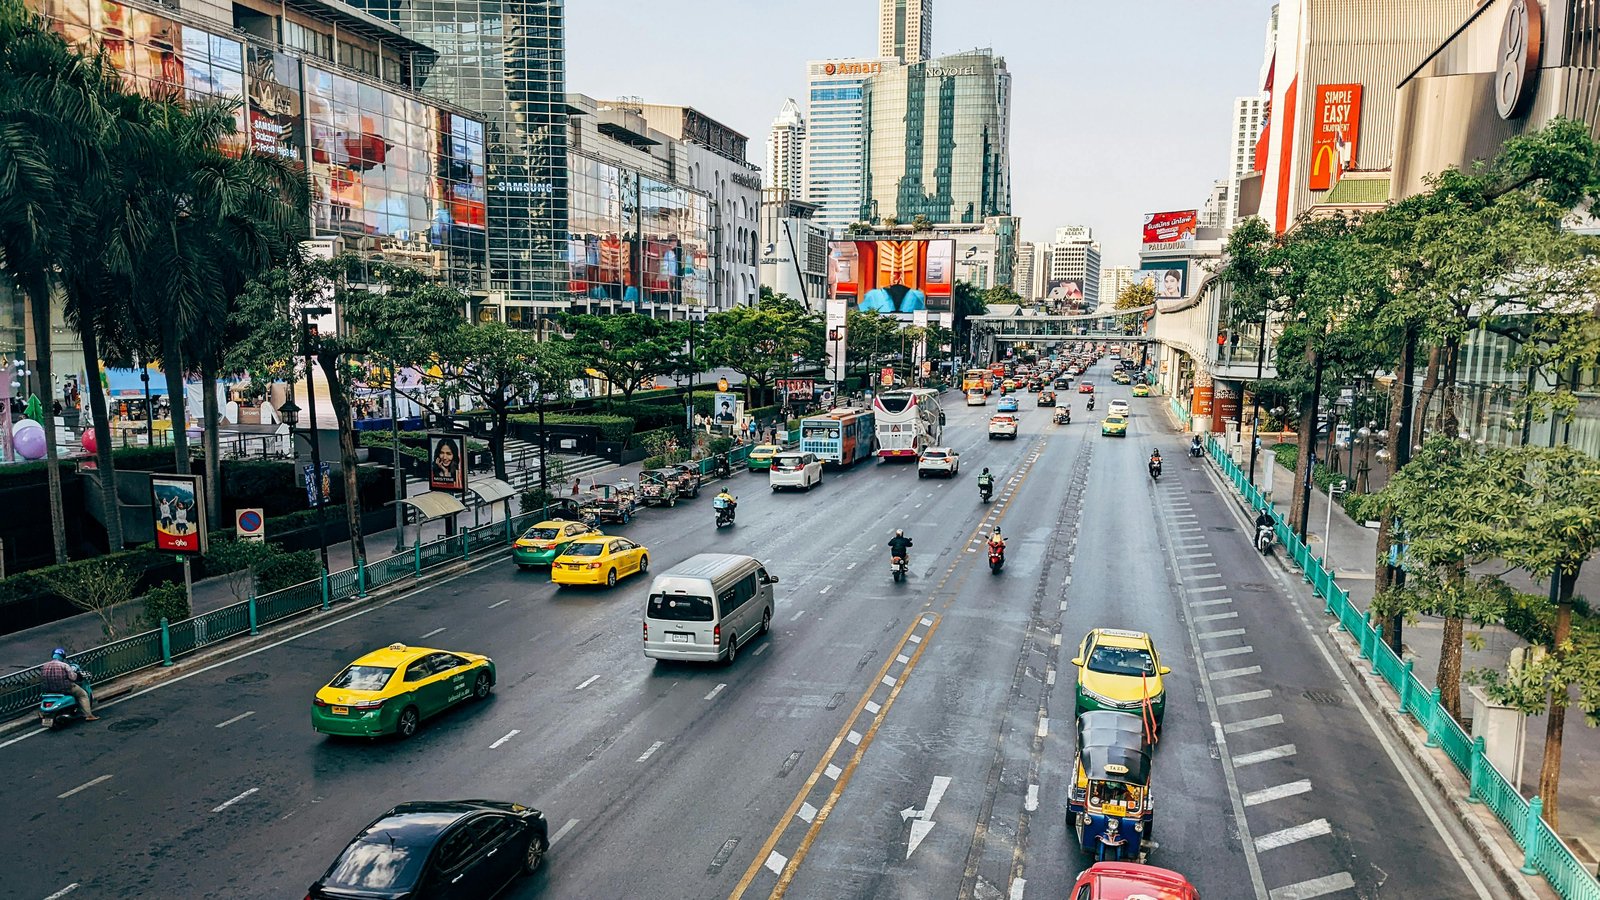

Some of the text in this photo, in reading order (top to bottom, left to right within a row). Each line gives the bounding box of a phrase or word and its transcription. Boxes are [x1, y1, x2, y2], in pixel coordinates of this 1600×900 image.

[837, 62, 881, 75] Amari
[925, 66, 977, 77] NOVOTEL
[1325, 91, 1352, 104] SIMPLE
[1323, 105, 1351, 123] EASY
[254, 120, 283, 134] SAMSUNG
[255, 132, 276, 144] Galaxy
[498, 182, 552, 193] SAMSUNG
[1148, 241, 1186, 250] PALLADIUM
